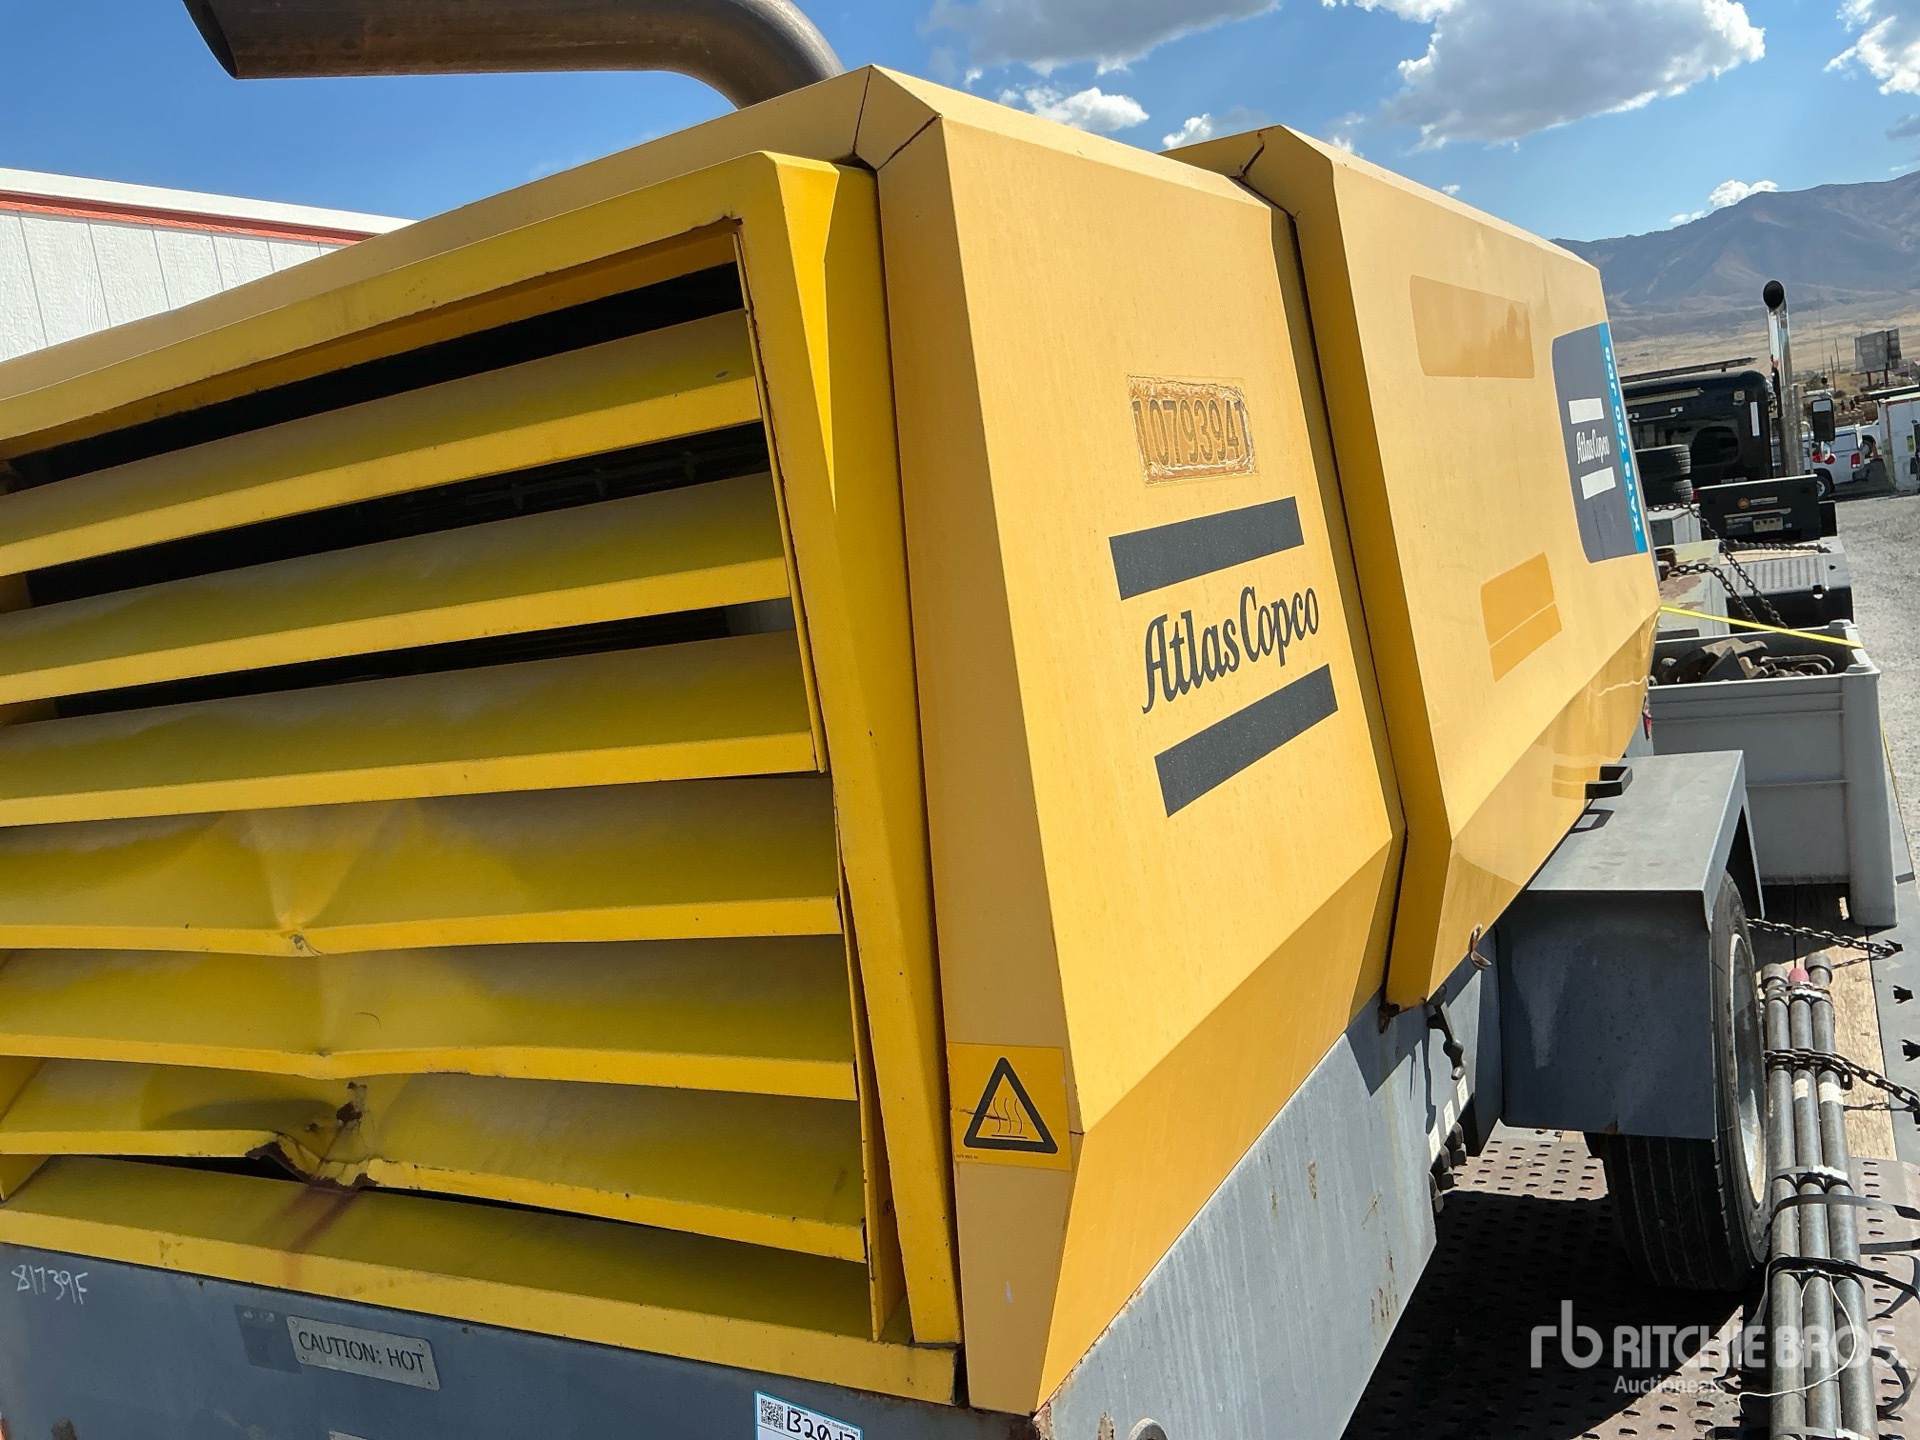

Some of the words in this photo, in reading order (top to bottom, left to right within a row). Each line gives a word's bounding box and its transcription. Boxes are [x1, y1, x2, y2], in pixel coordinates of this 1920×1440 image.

[1615, 405, 1627, 453] 750
[1624, 461, 1641, 533] XATS
[11, 1264, 89, 1305] 81739F
[298, 1331, 383, 1366] CAUTION:
[386, 1347, 424, 1373] HOT
